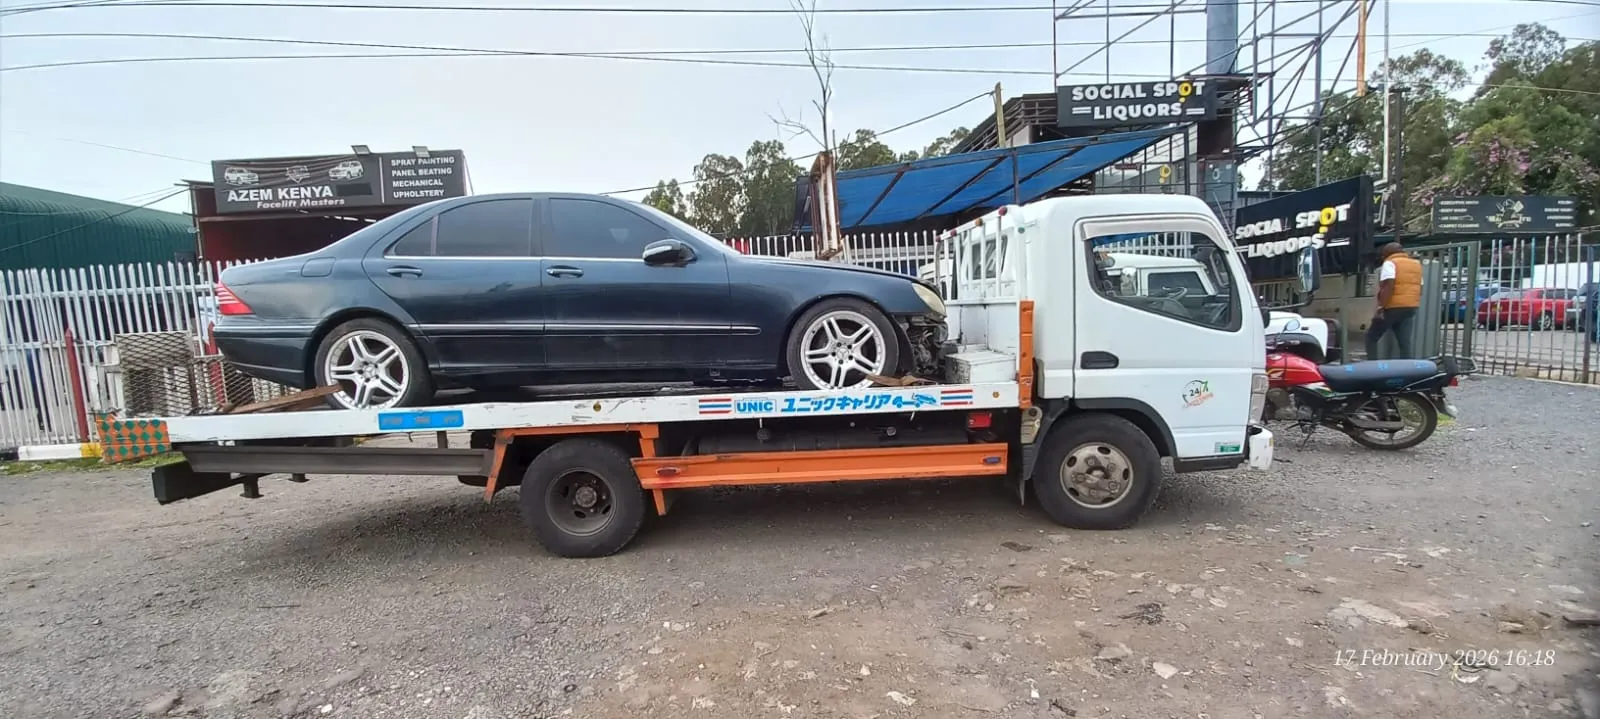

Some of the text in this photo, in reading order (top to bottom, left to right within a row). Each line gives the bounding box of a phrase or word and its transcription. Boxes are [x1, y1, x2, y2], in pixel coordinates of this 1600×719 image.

[1072, 81, 1205, 101] SOCIAL SPOT
[1094, 103, 1182, 121] LIQUORS
[391, 156, 455, 167] SPRAY PAINTING
[391, 167, 453, 177] PANEL BEATING
[392, 179, 444, 188] MECHANICAL
[227, 185, 334, 203] AZEM KENYA
[393, 189, 445, 199] UPHOLSTERY
[256, 197, 345, 209] Facelift Masters
[1295, 203, 1351, 229] SPOT
[736, 401, 774, 413] UNIC
[781, 394, 892, 413] ユニックキャリア
